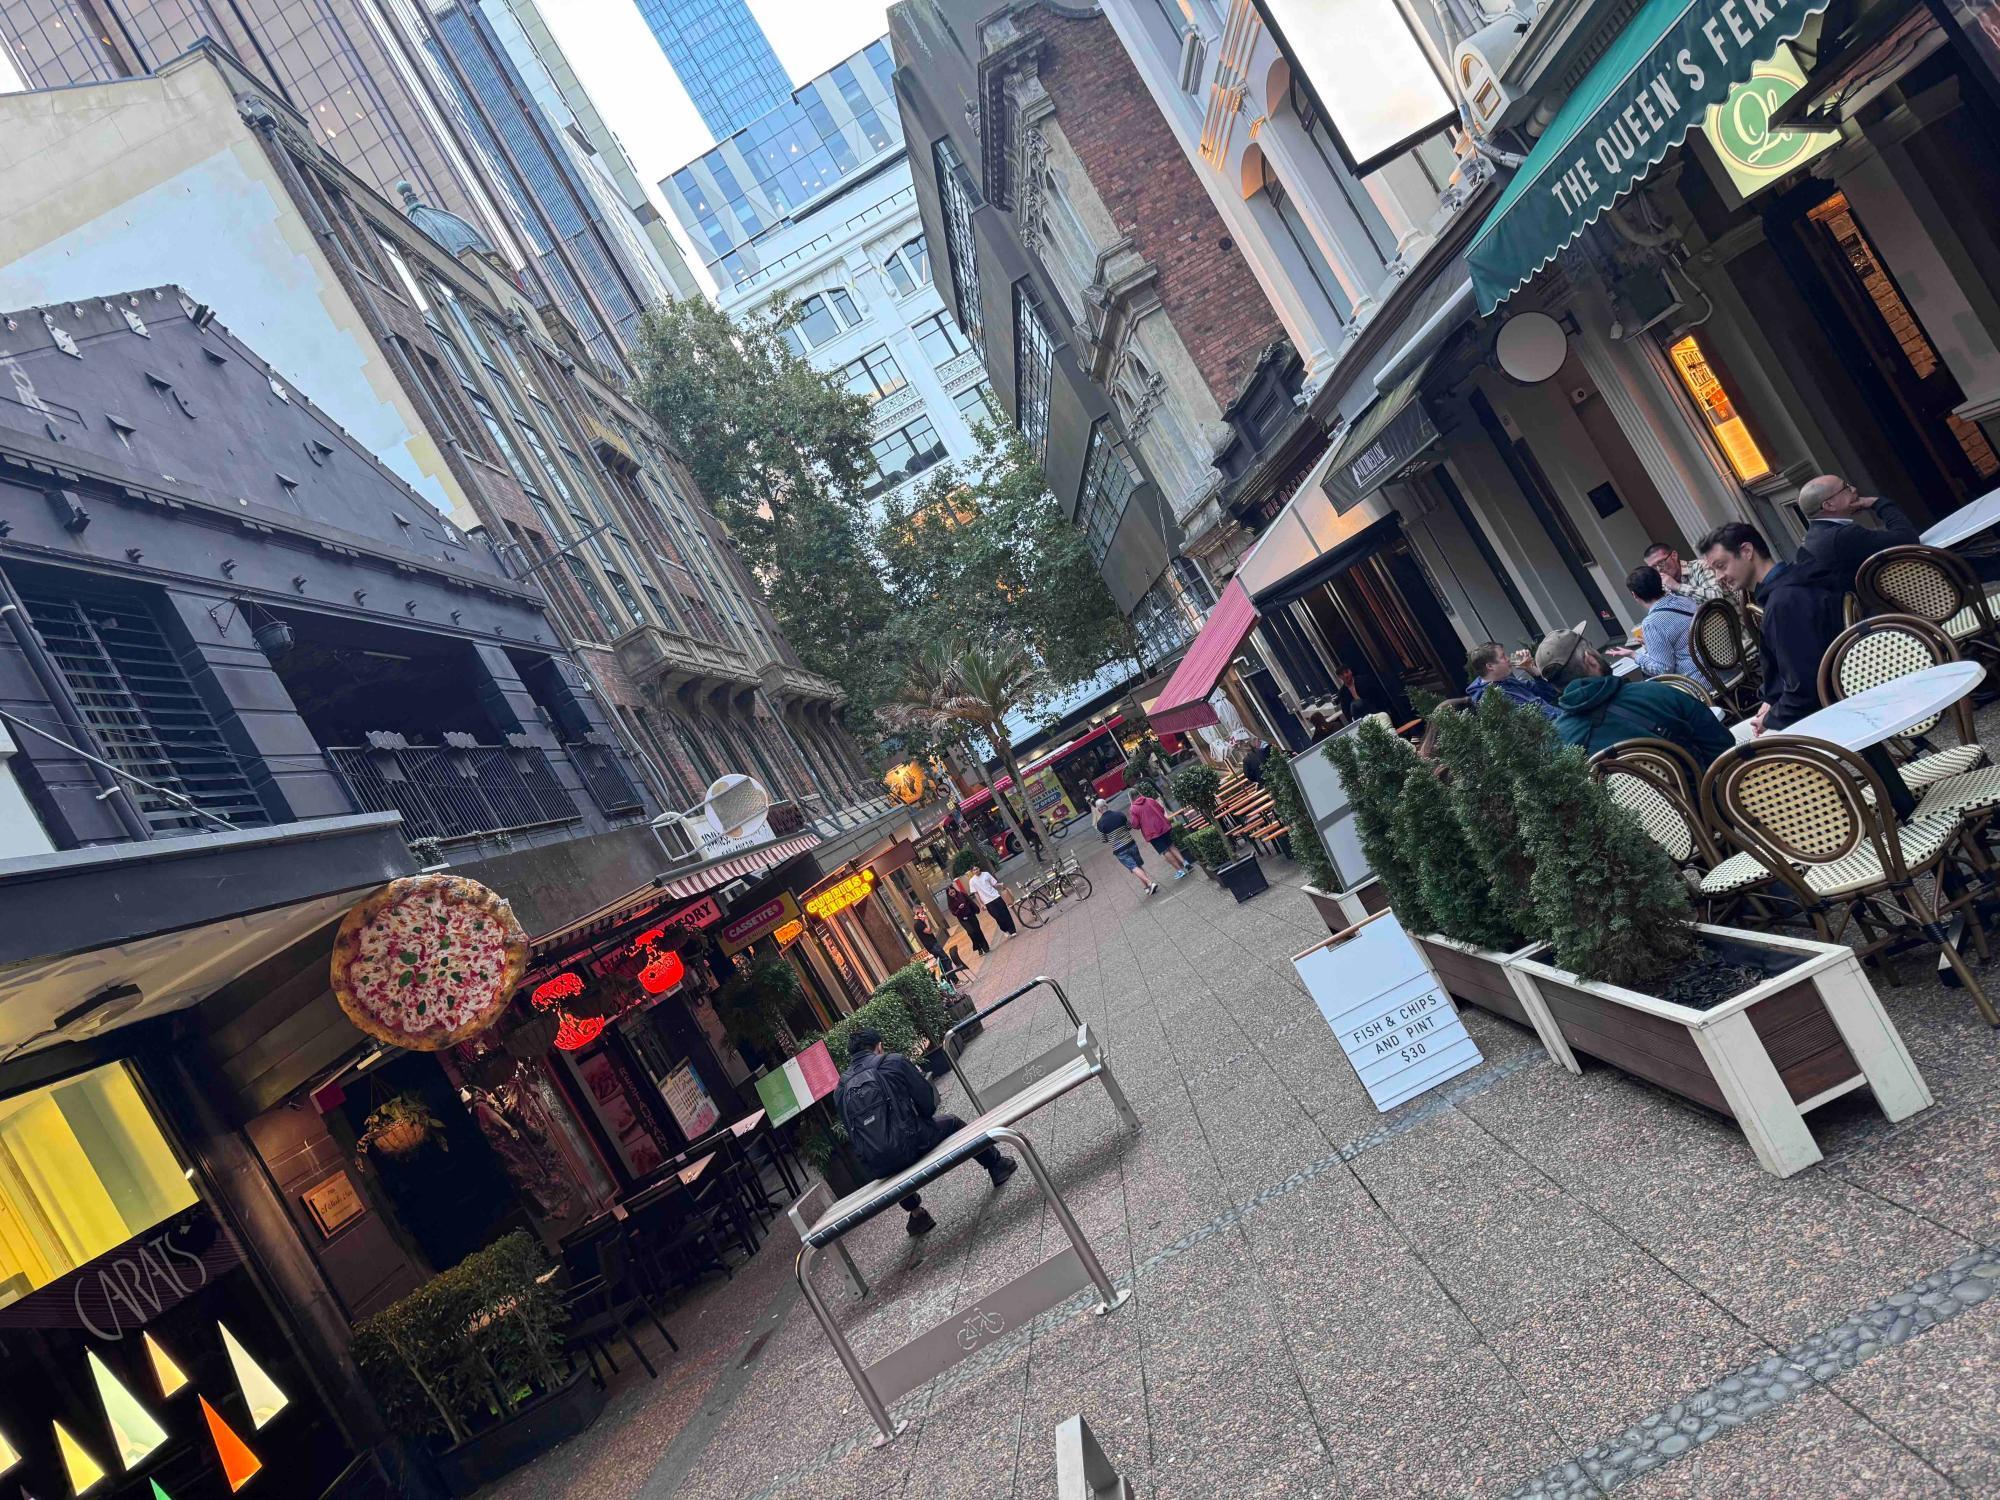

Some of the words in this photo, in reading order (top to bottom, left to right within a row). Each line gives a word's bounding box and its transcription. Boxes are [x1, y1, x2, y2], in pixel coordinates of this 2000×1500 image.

[1551, 157, 1598, 217] THE
[1594, 49, 1706, 173] QUEEN'S
[1701, 0, 1787, 66] FER
[806, 878, 862, 913] CURRIES
[862, 869, 874, 882] &
[818, 882, 872, 919] KEBABS
[1353, 1022, 1383, 1044] FISH
[1386, 1015, 1396, 1028] &
[1400, 995, 1436, 1020] CHIPS
[1375, 1034, 1400, 1055] AND
[1406, 1016, 1435, 1039] PINT
[1401, 1043, 1427, 1064] $30
[618, 1068, 670, 1150] RESTAURANT
[75, 1231, 206, 1342] CARATS
